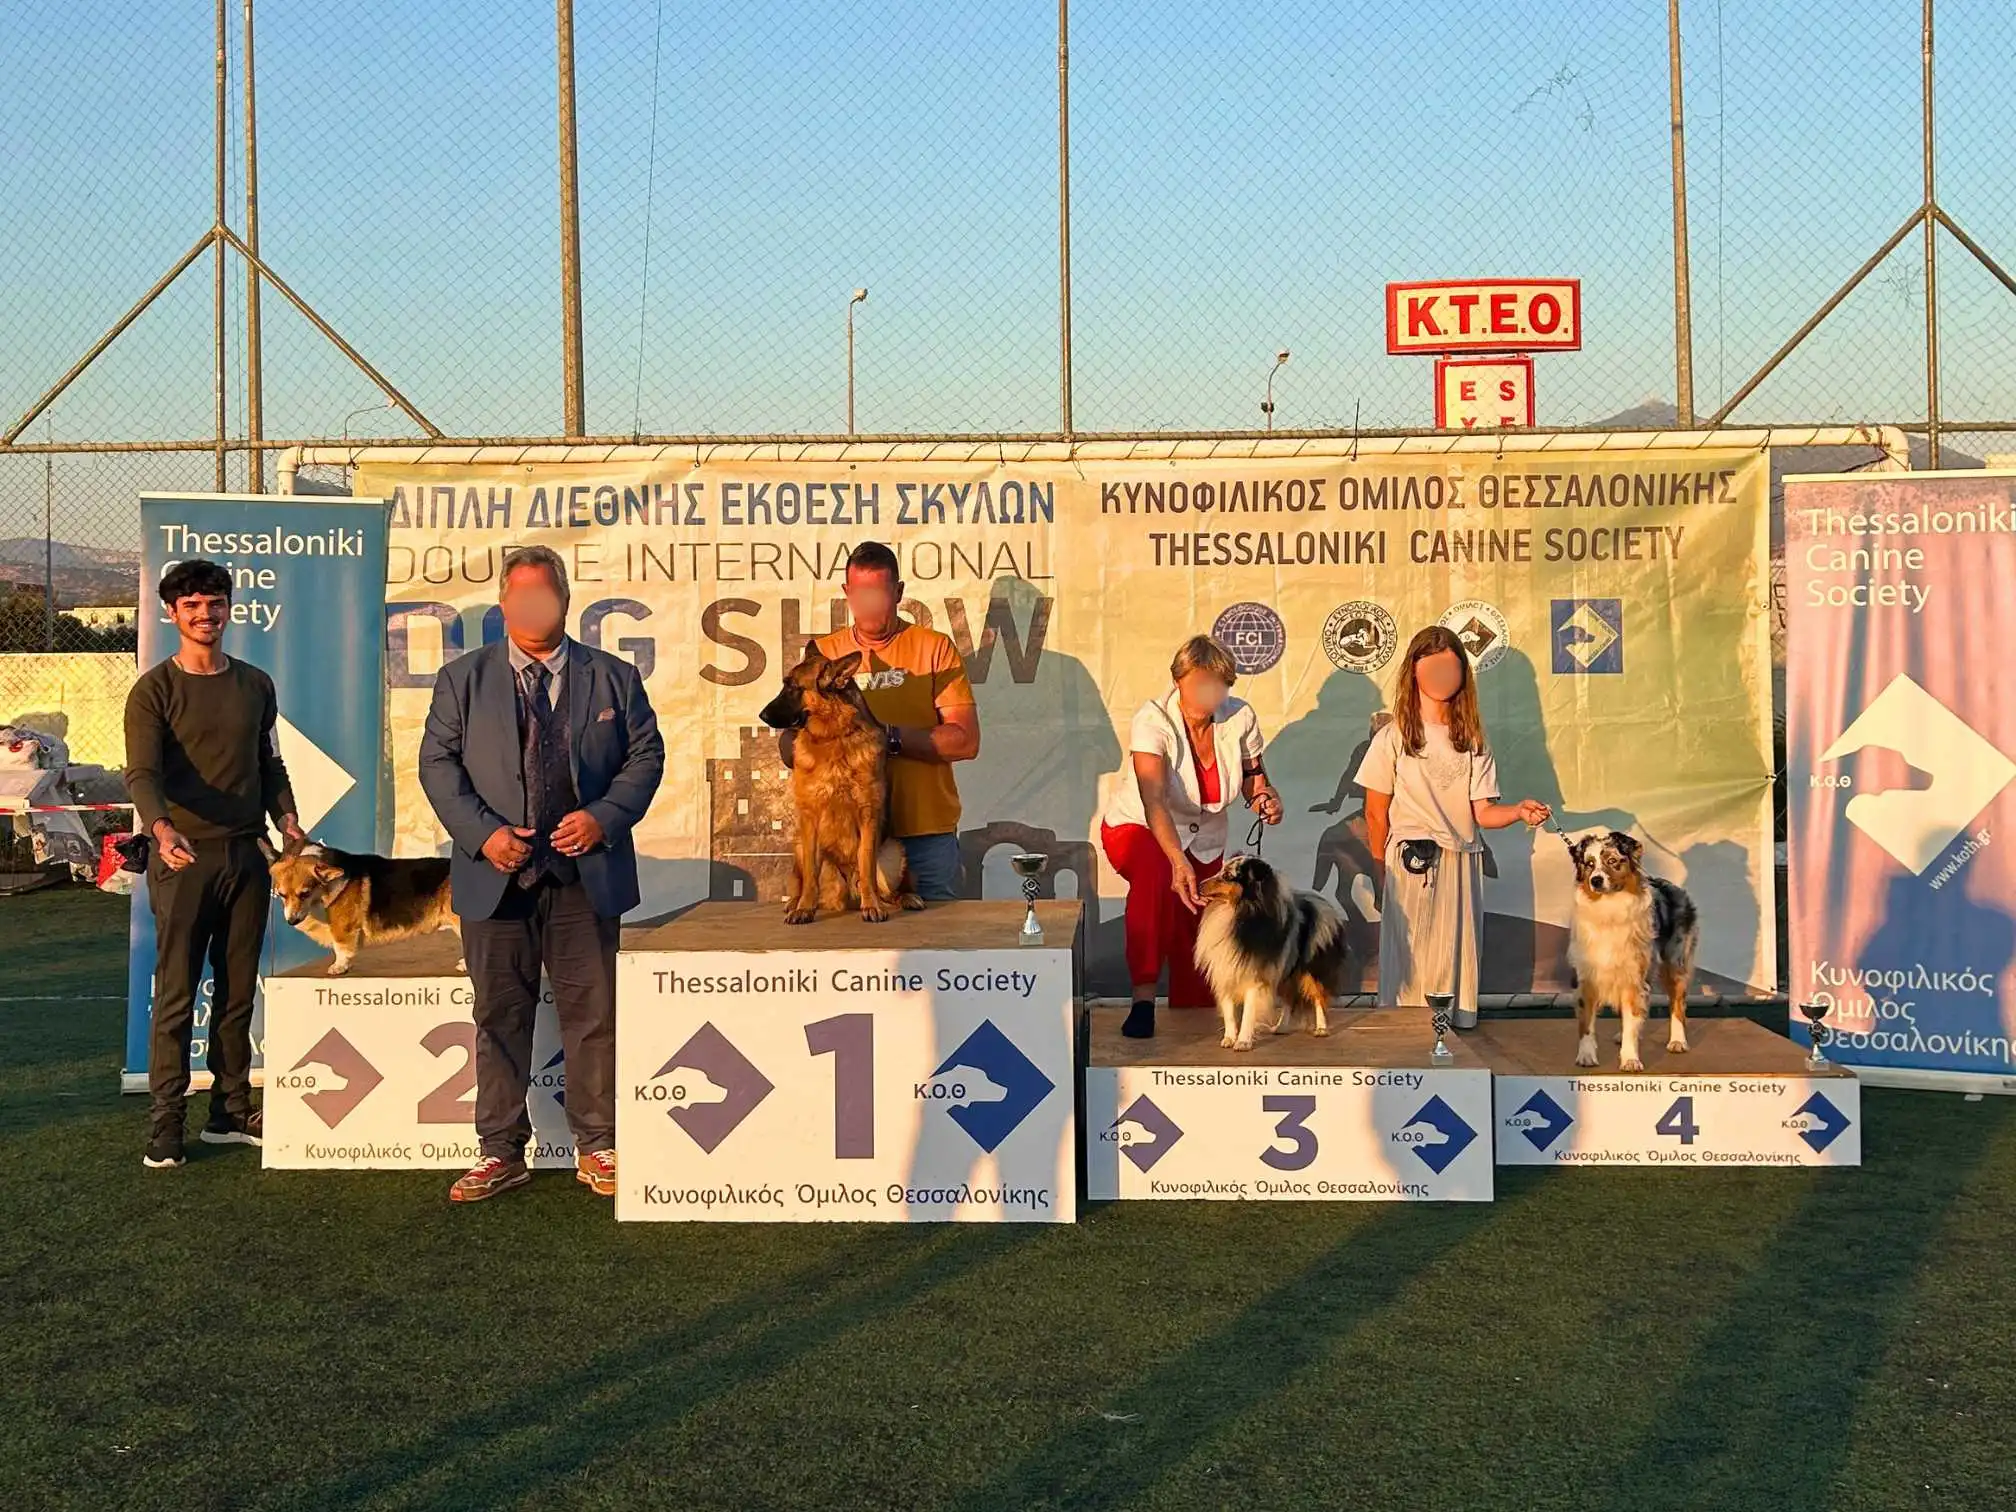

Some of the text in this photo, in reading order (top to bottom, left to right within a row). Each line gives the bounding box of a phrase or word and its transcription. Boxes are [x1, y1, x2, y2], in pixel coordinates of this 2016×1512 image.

[1460, 380, 1515, 401] E S
[390, 480, 1055, 529] ΔΙΠΛΗ ΔΙΕΘΝΗΣ ΕΚΘΕΣΗ ΣΚΥΛΩΝ
[1101, 470, 1738, 514] ΚΥΝΟΦΙΛΙΚΟΣ ΟΜΙΛΟΣ ΘΕΣΣΑΛΟΝΙΚΗΣ
[1800, 503, 2016, 536] Thessaloniki
[159, 524, 364, 556] Thessaloniki
[1149, 526, 1685, 566] THESSALONIKI CANINE SOCIETY
[386, 540, 1055, 585] DOUE INTERNAIONAL
[1806, 542, 1925, 572] Canine
[1806, 578, 1932, 613] Society
[699, 597, 1055, 686] SHW
[1235, 631, 1263, 645] FCI
[1929, 828, 1991, 890] www.koth.gr
[653, 968, 1037, 998] Thessaloniki Canine Society
[1810, 960, 1993, 997] Κυνοφιλικός
[315, 988, 440, 1006] Thessaloniki
[417, 1021, 477, 1124] 2
[804, 1013, 874, 1159] 1
[1152, 1070, 1424, 1090] Thessaloniki Canine Society
[1568, 1080, 1786, 1096] Thessaloniki Canine Society
[1259, 1095, 1319, 1171] 3
[1655, 1096, 1700, 1145] 4
[305, 1143, 411, 1163] Κυνοφιλικός
[1554, 1150, 1801, 1164] Κυνοφιλικός Όμιλος Θεσσαλονίκης
[644, 1183, 1049, 1209] Κυνοφιλικός Όμιλος Θεσσαλονίκης
[1151, 1180, 1429, 1197] Κυνοφιλικός Όμιλος Θεσσαλονίκης
